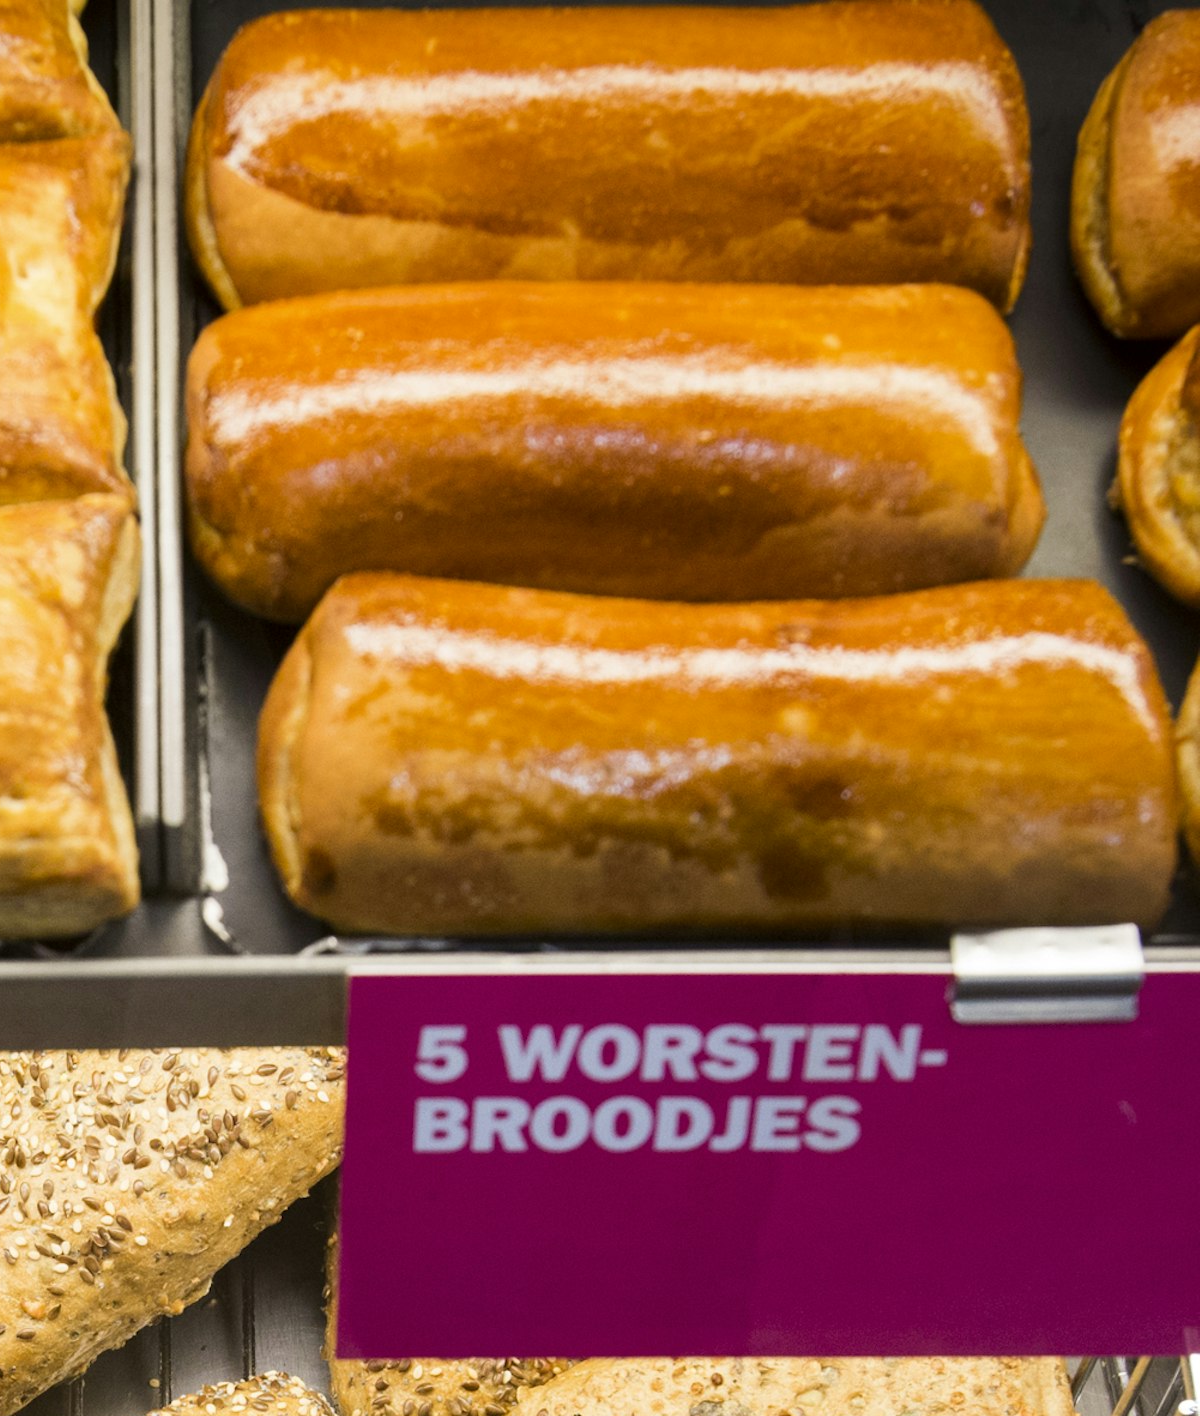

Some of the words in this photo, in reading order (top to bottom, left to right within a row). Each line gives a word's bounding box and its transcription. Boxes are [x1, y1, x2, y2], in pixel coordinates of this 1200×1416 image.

[415, 1025, 468, 1082] 5
[498, 1024, 947, 1082] WORSTEN-
[413, 1096, 863, 1153] BROODJES
